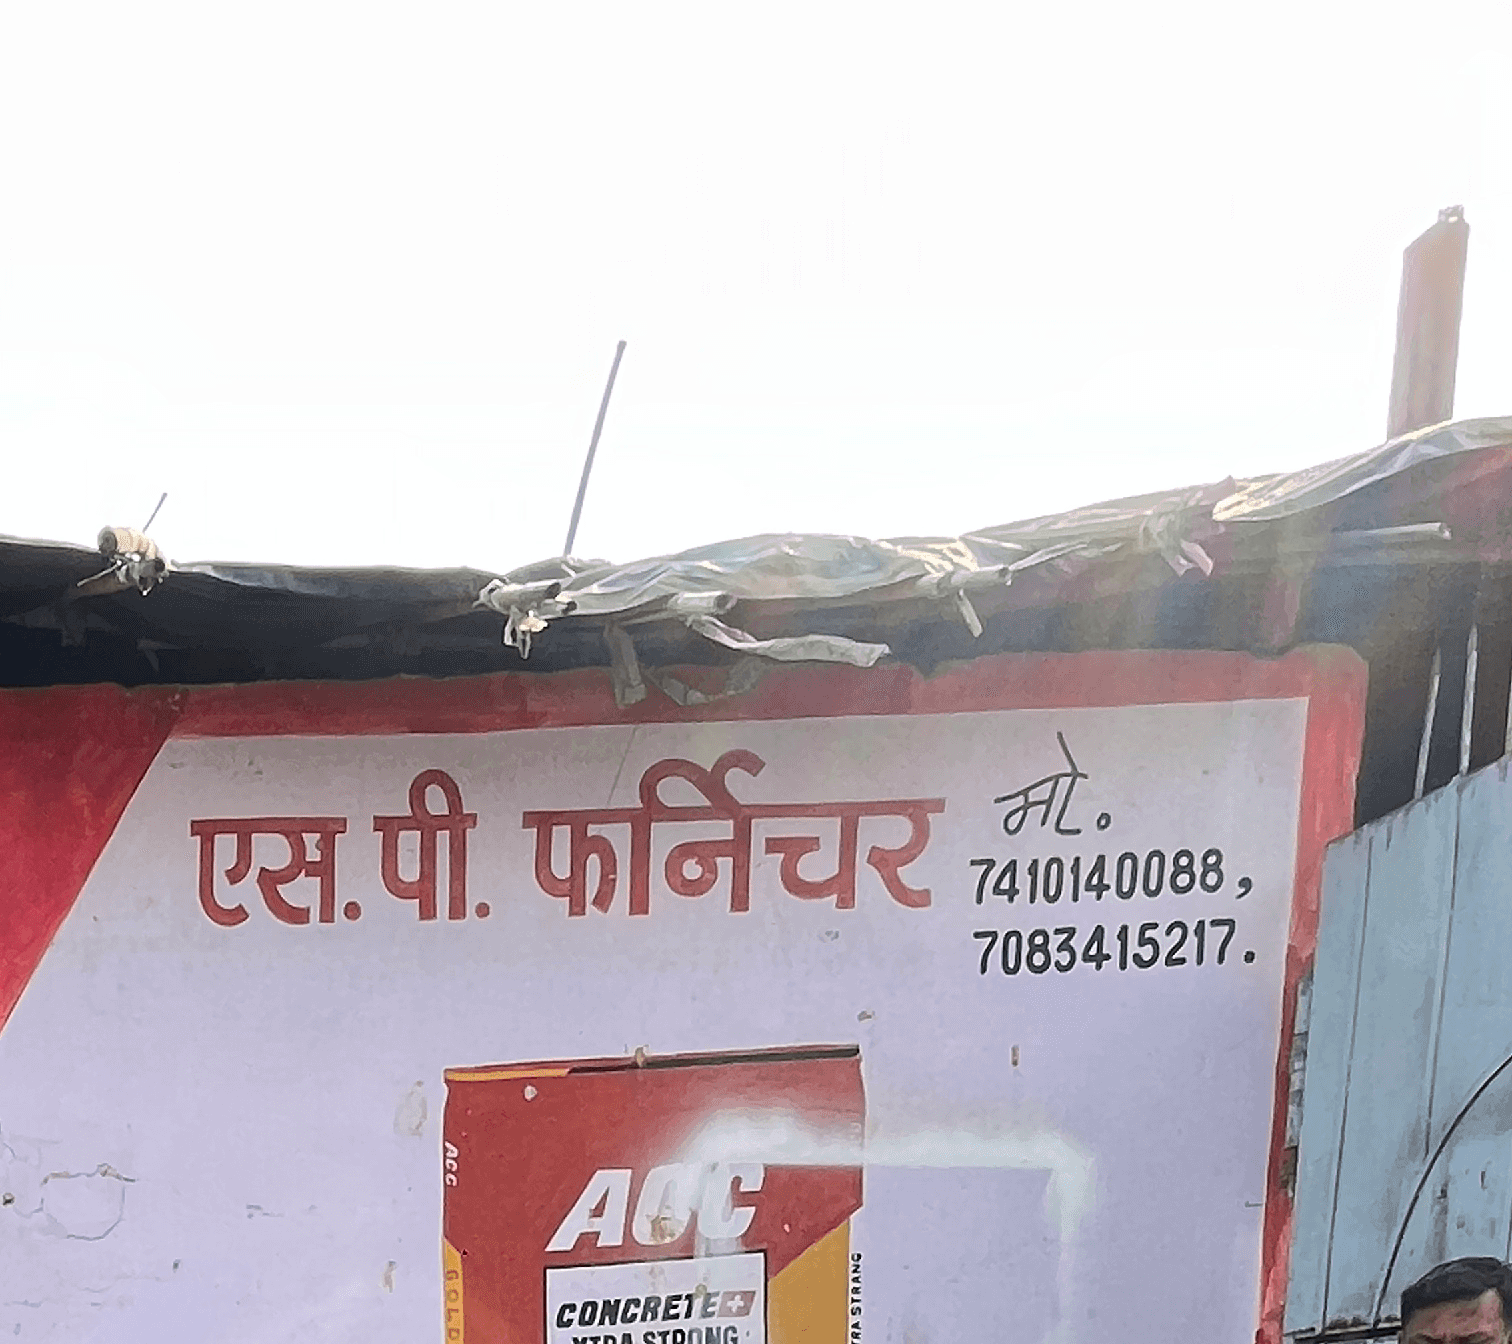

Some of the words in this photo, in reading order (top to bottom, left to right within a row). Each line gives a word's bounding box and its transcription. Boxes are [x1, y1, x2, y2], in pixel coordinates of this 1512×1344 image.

[522, 749, 947, 917] फर्निचर
[969, 848, 1254, 905] 7410140088,
[973, 918, 1257, 976] 7083415217.
[445, 1269, 461, 1343] GOLD
[555, 1290, 720, 1329] CONCRETE
